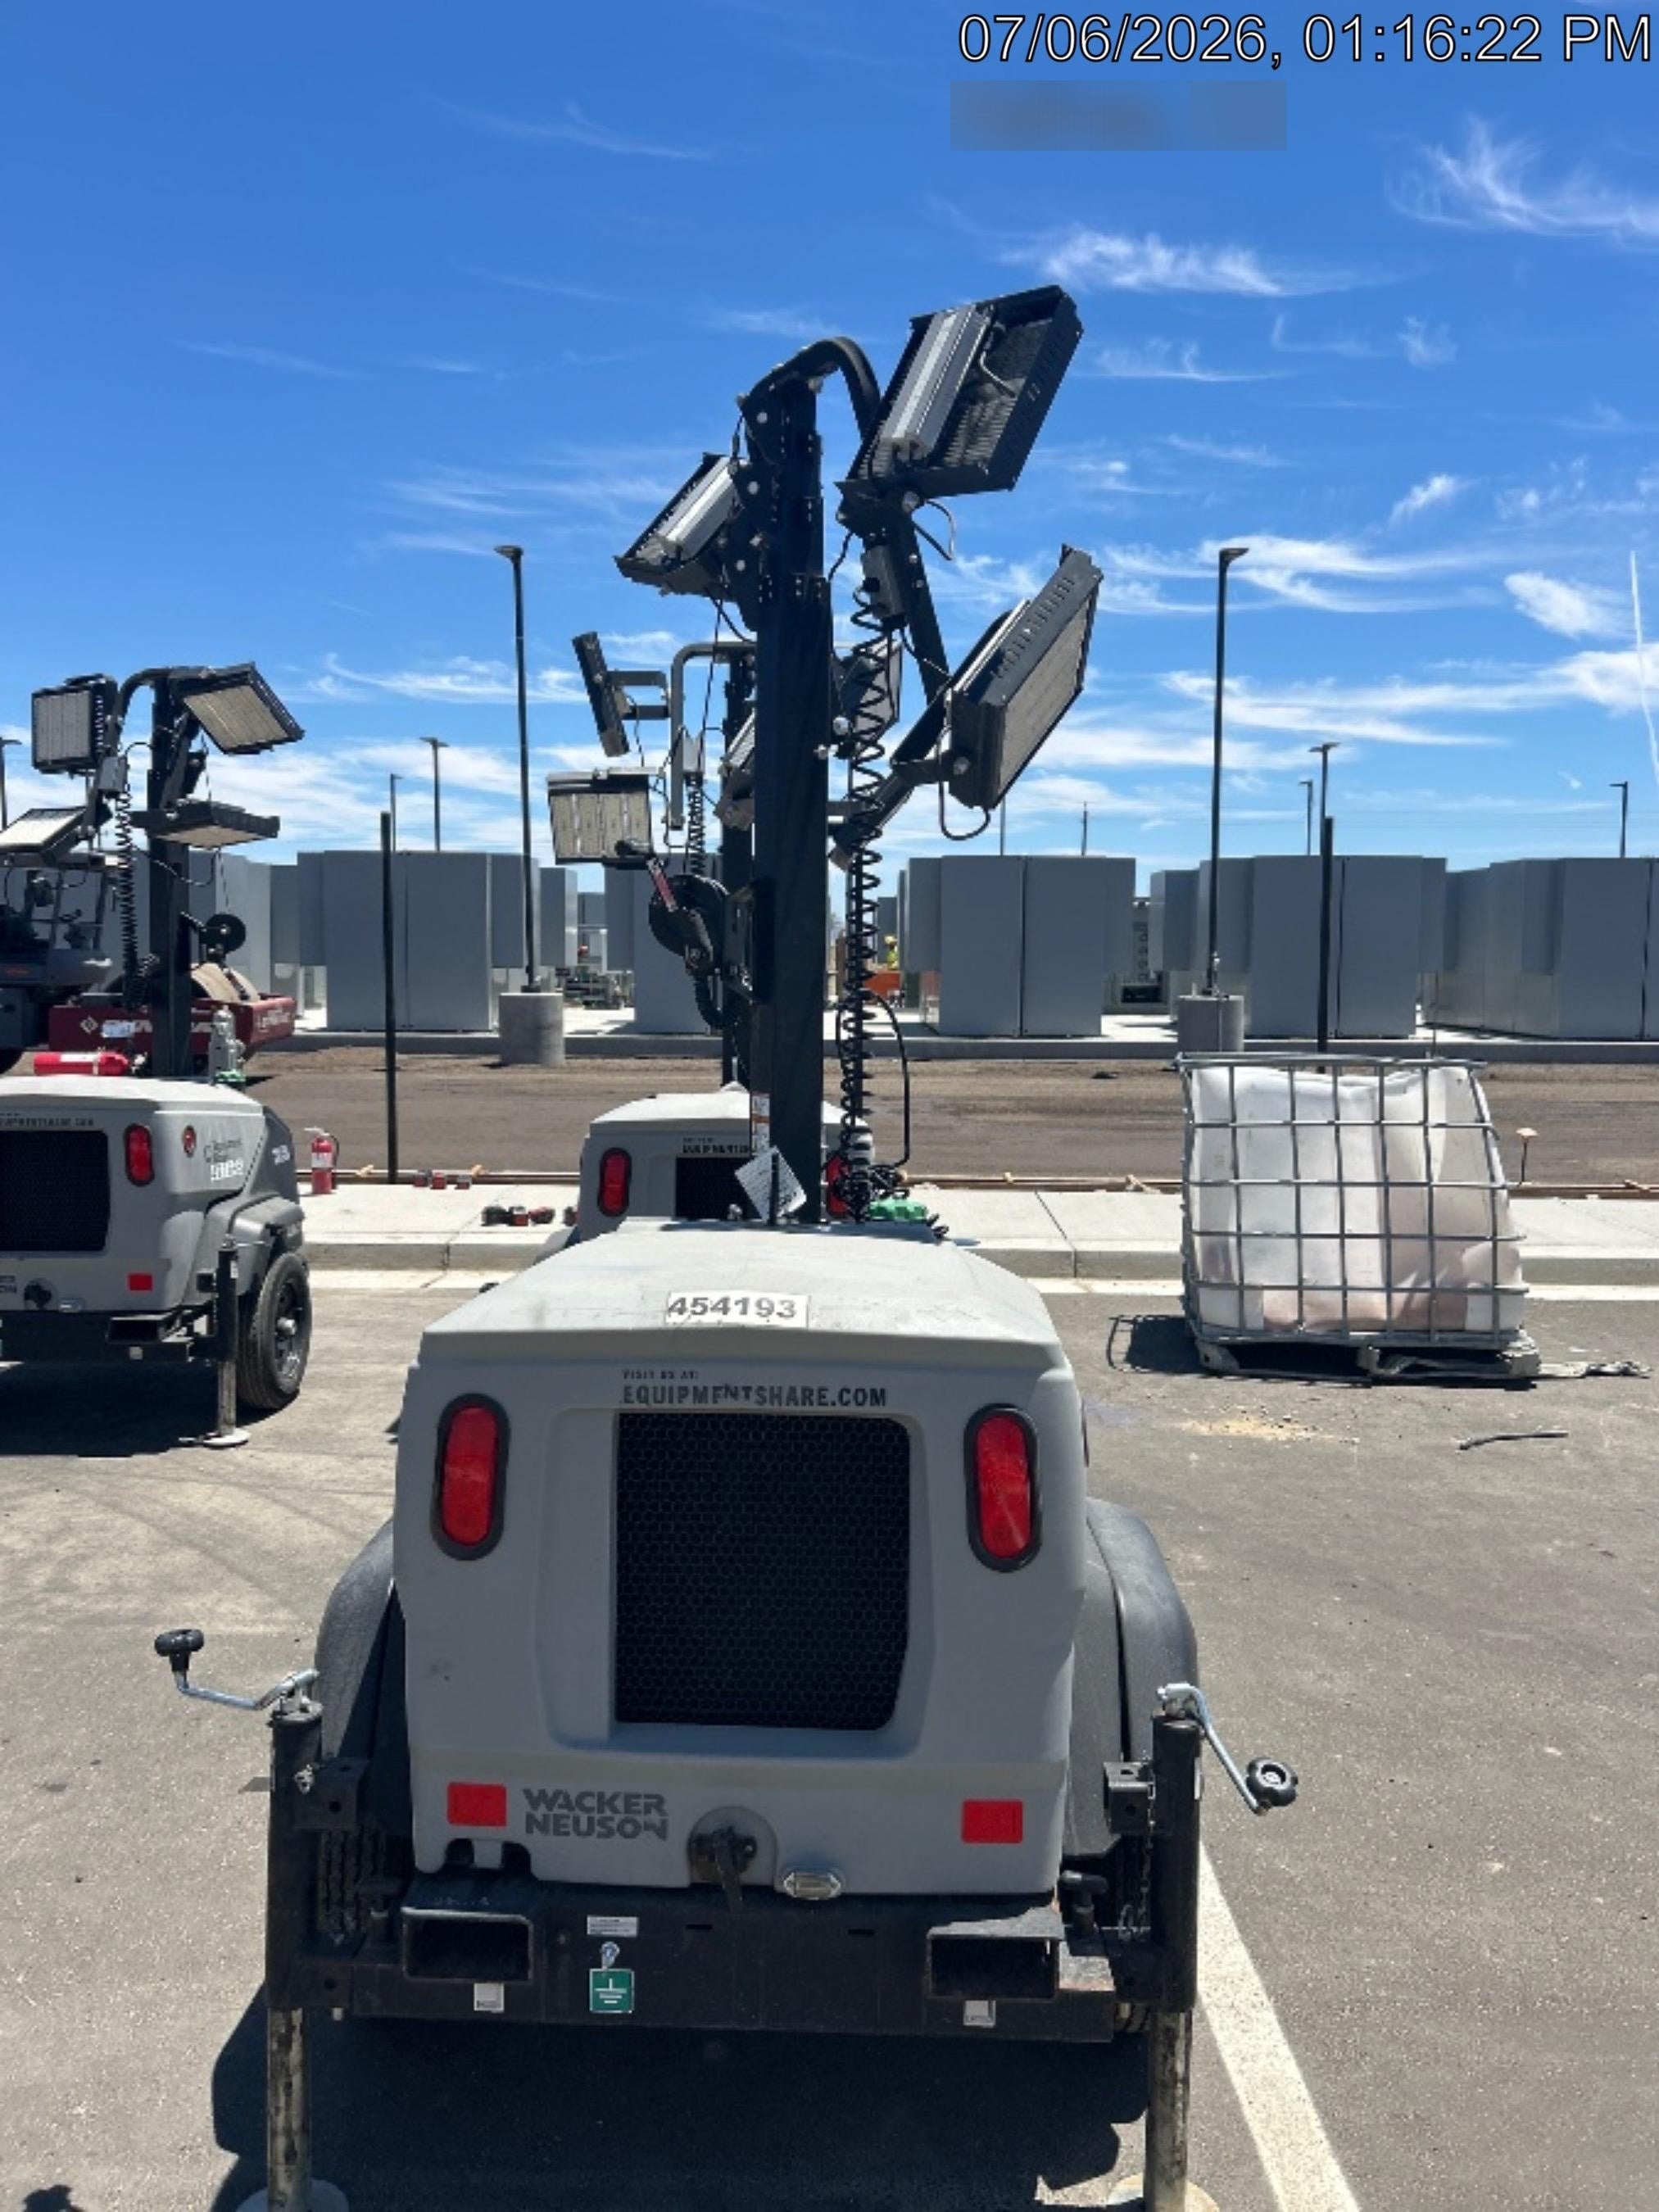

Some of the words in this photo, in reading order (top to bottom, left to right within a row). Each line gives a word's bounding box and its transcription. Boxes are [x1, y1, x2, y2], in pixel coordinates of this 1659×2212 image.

[668, 1296, 796, 1318] 454193
[622, 1384, 887, 1407] EQUIPMENTSHARE.COM
[523, 1788, 668, 1816] WACKER
[525, 1812, 668, 1841] NEUSON
